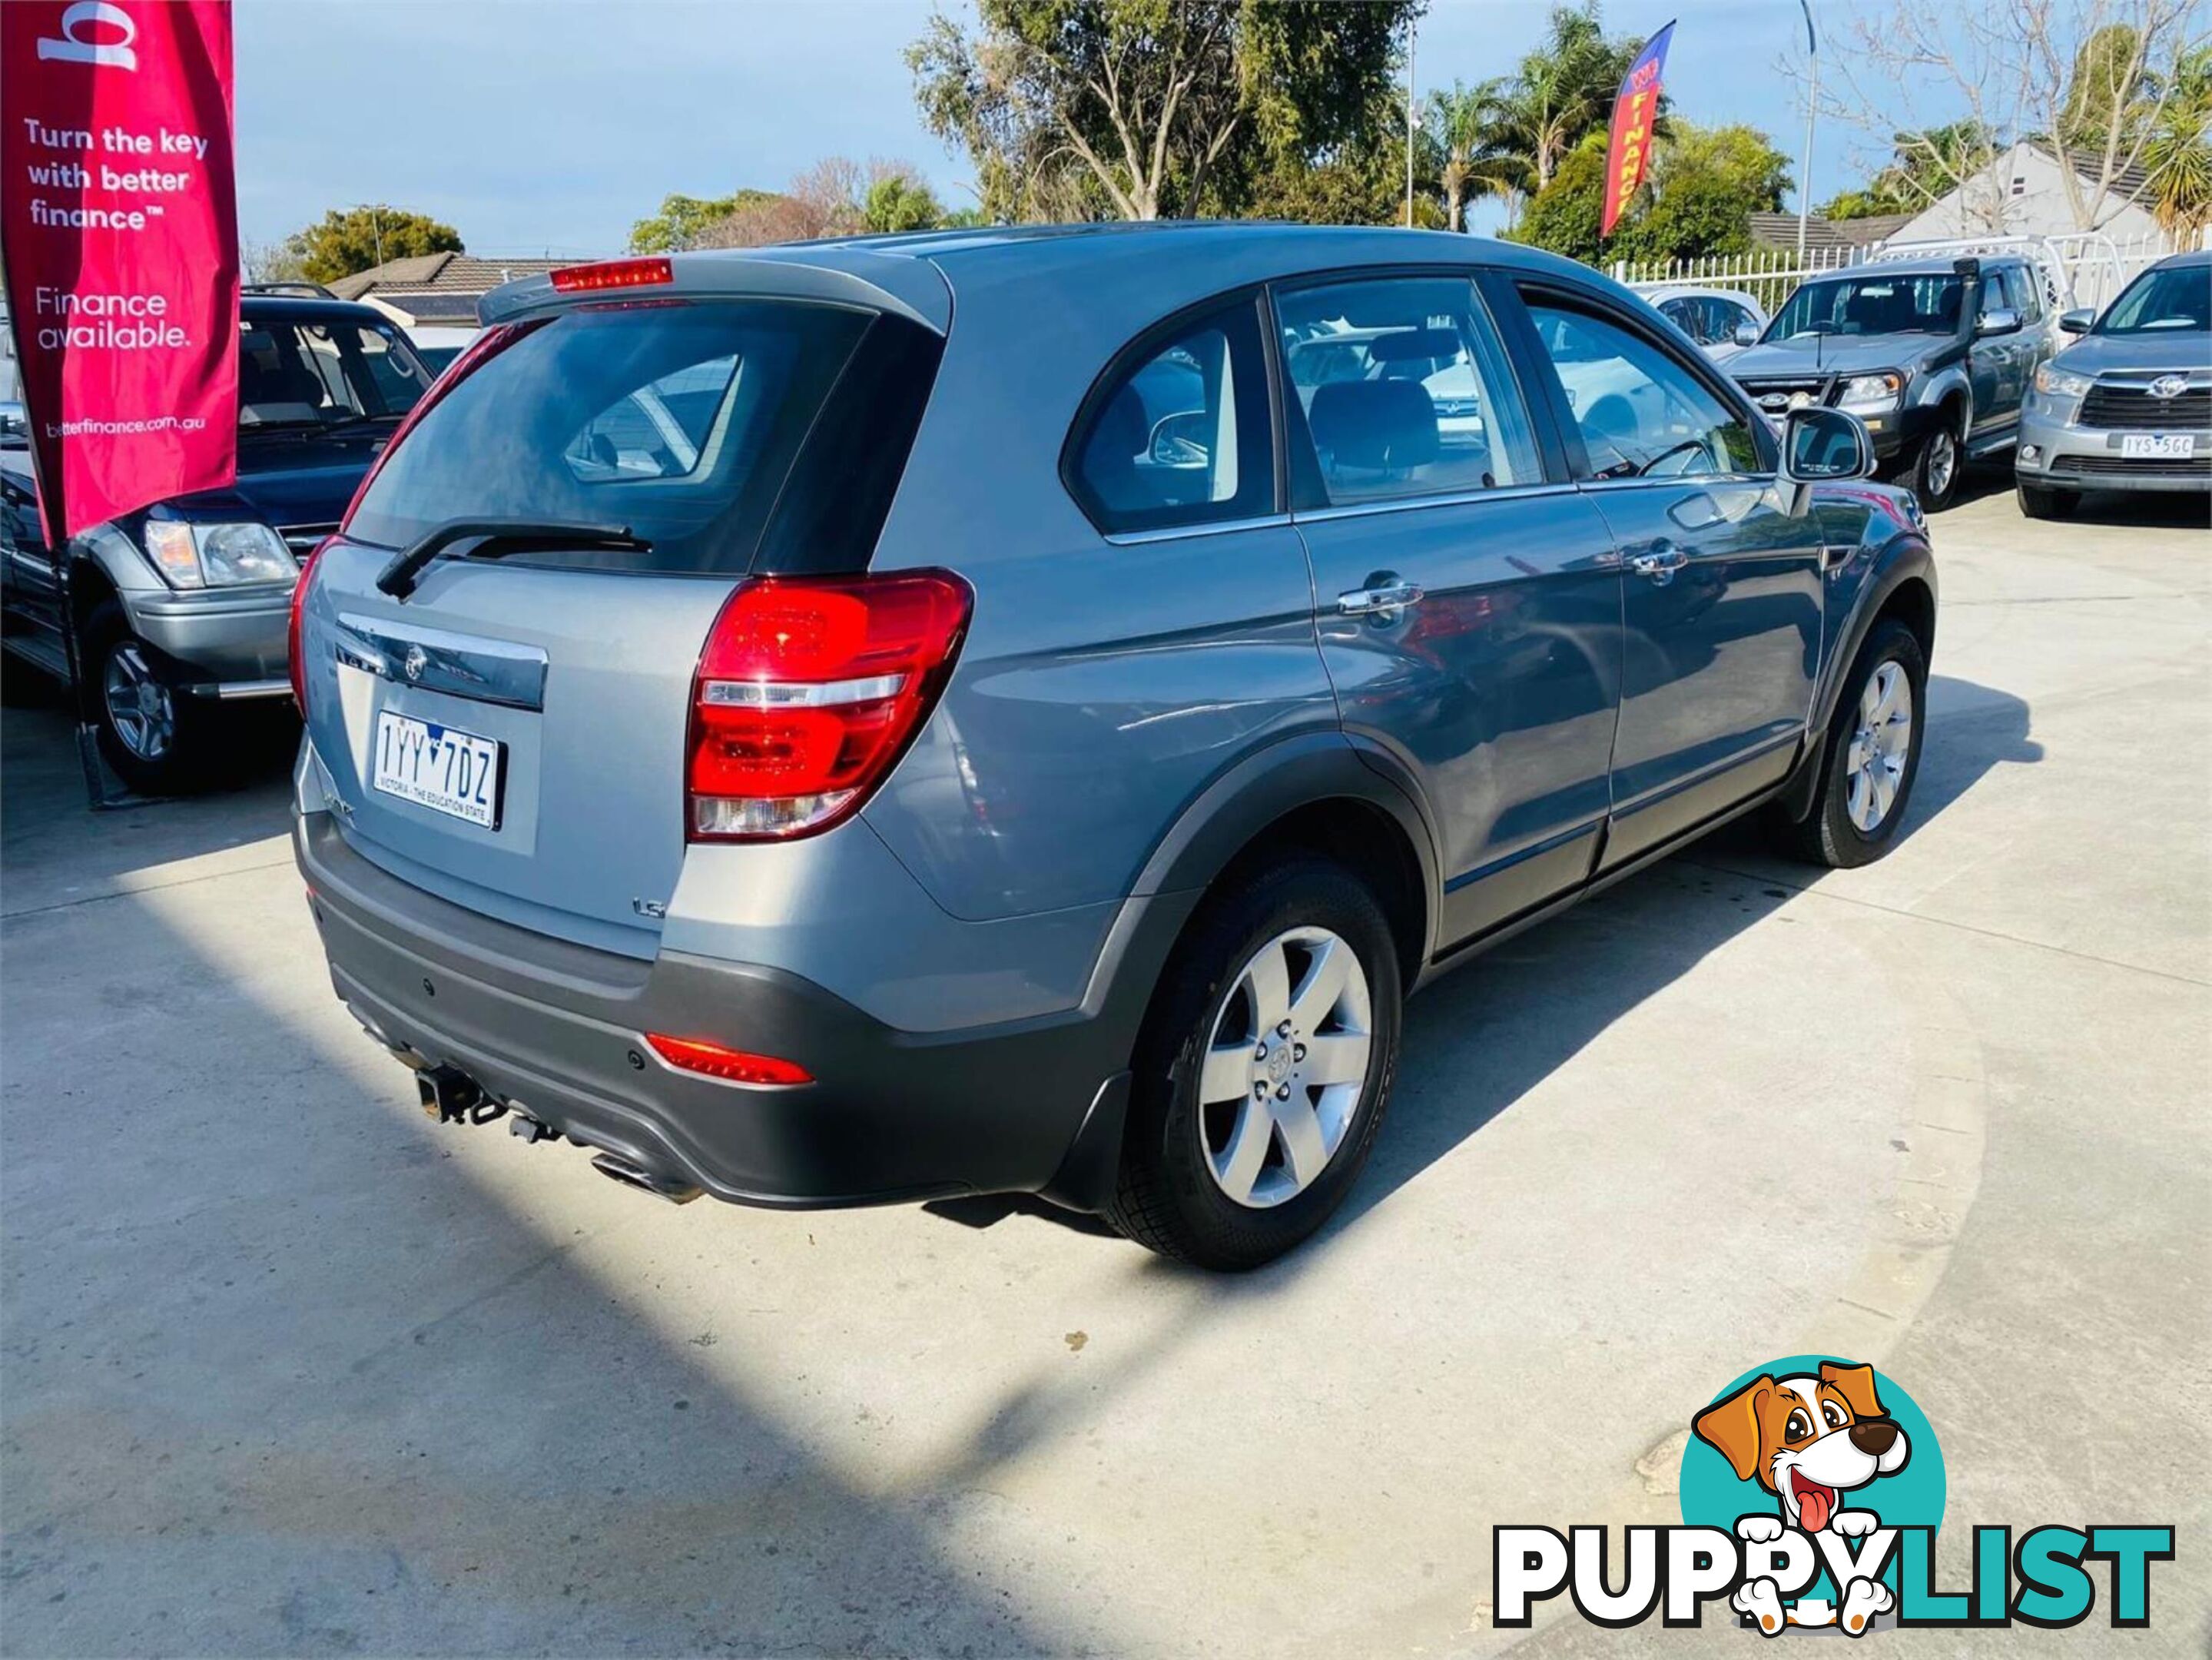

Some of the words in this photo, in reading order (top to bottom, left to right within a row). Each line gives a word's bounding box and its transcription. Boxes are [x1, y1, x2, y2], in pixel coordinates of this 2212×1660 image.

[24, 118, 94, 150] Turn
[102, 127, 152, 154] the
[160, 127, 208, 161] key
[28, 162, 91, 189] with
[101, 164, 190, 192] better
[36, 287, 167, 317] Finance
[38, 320, 191, 349] available.
